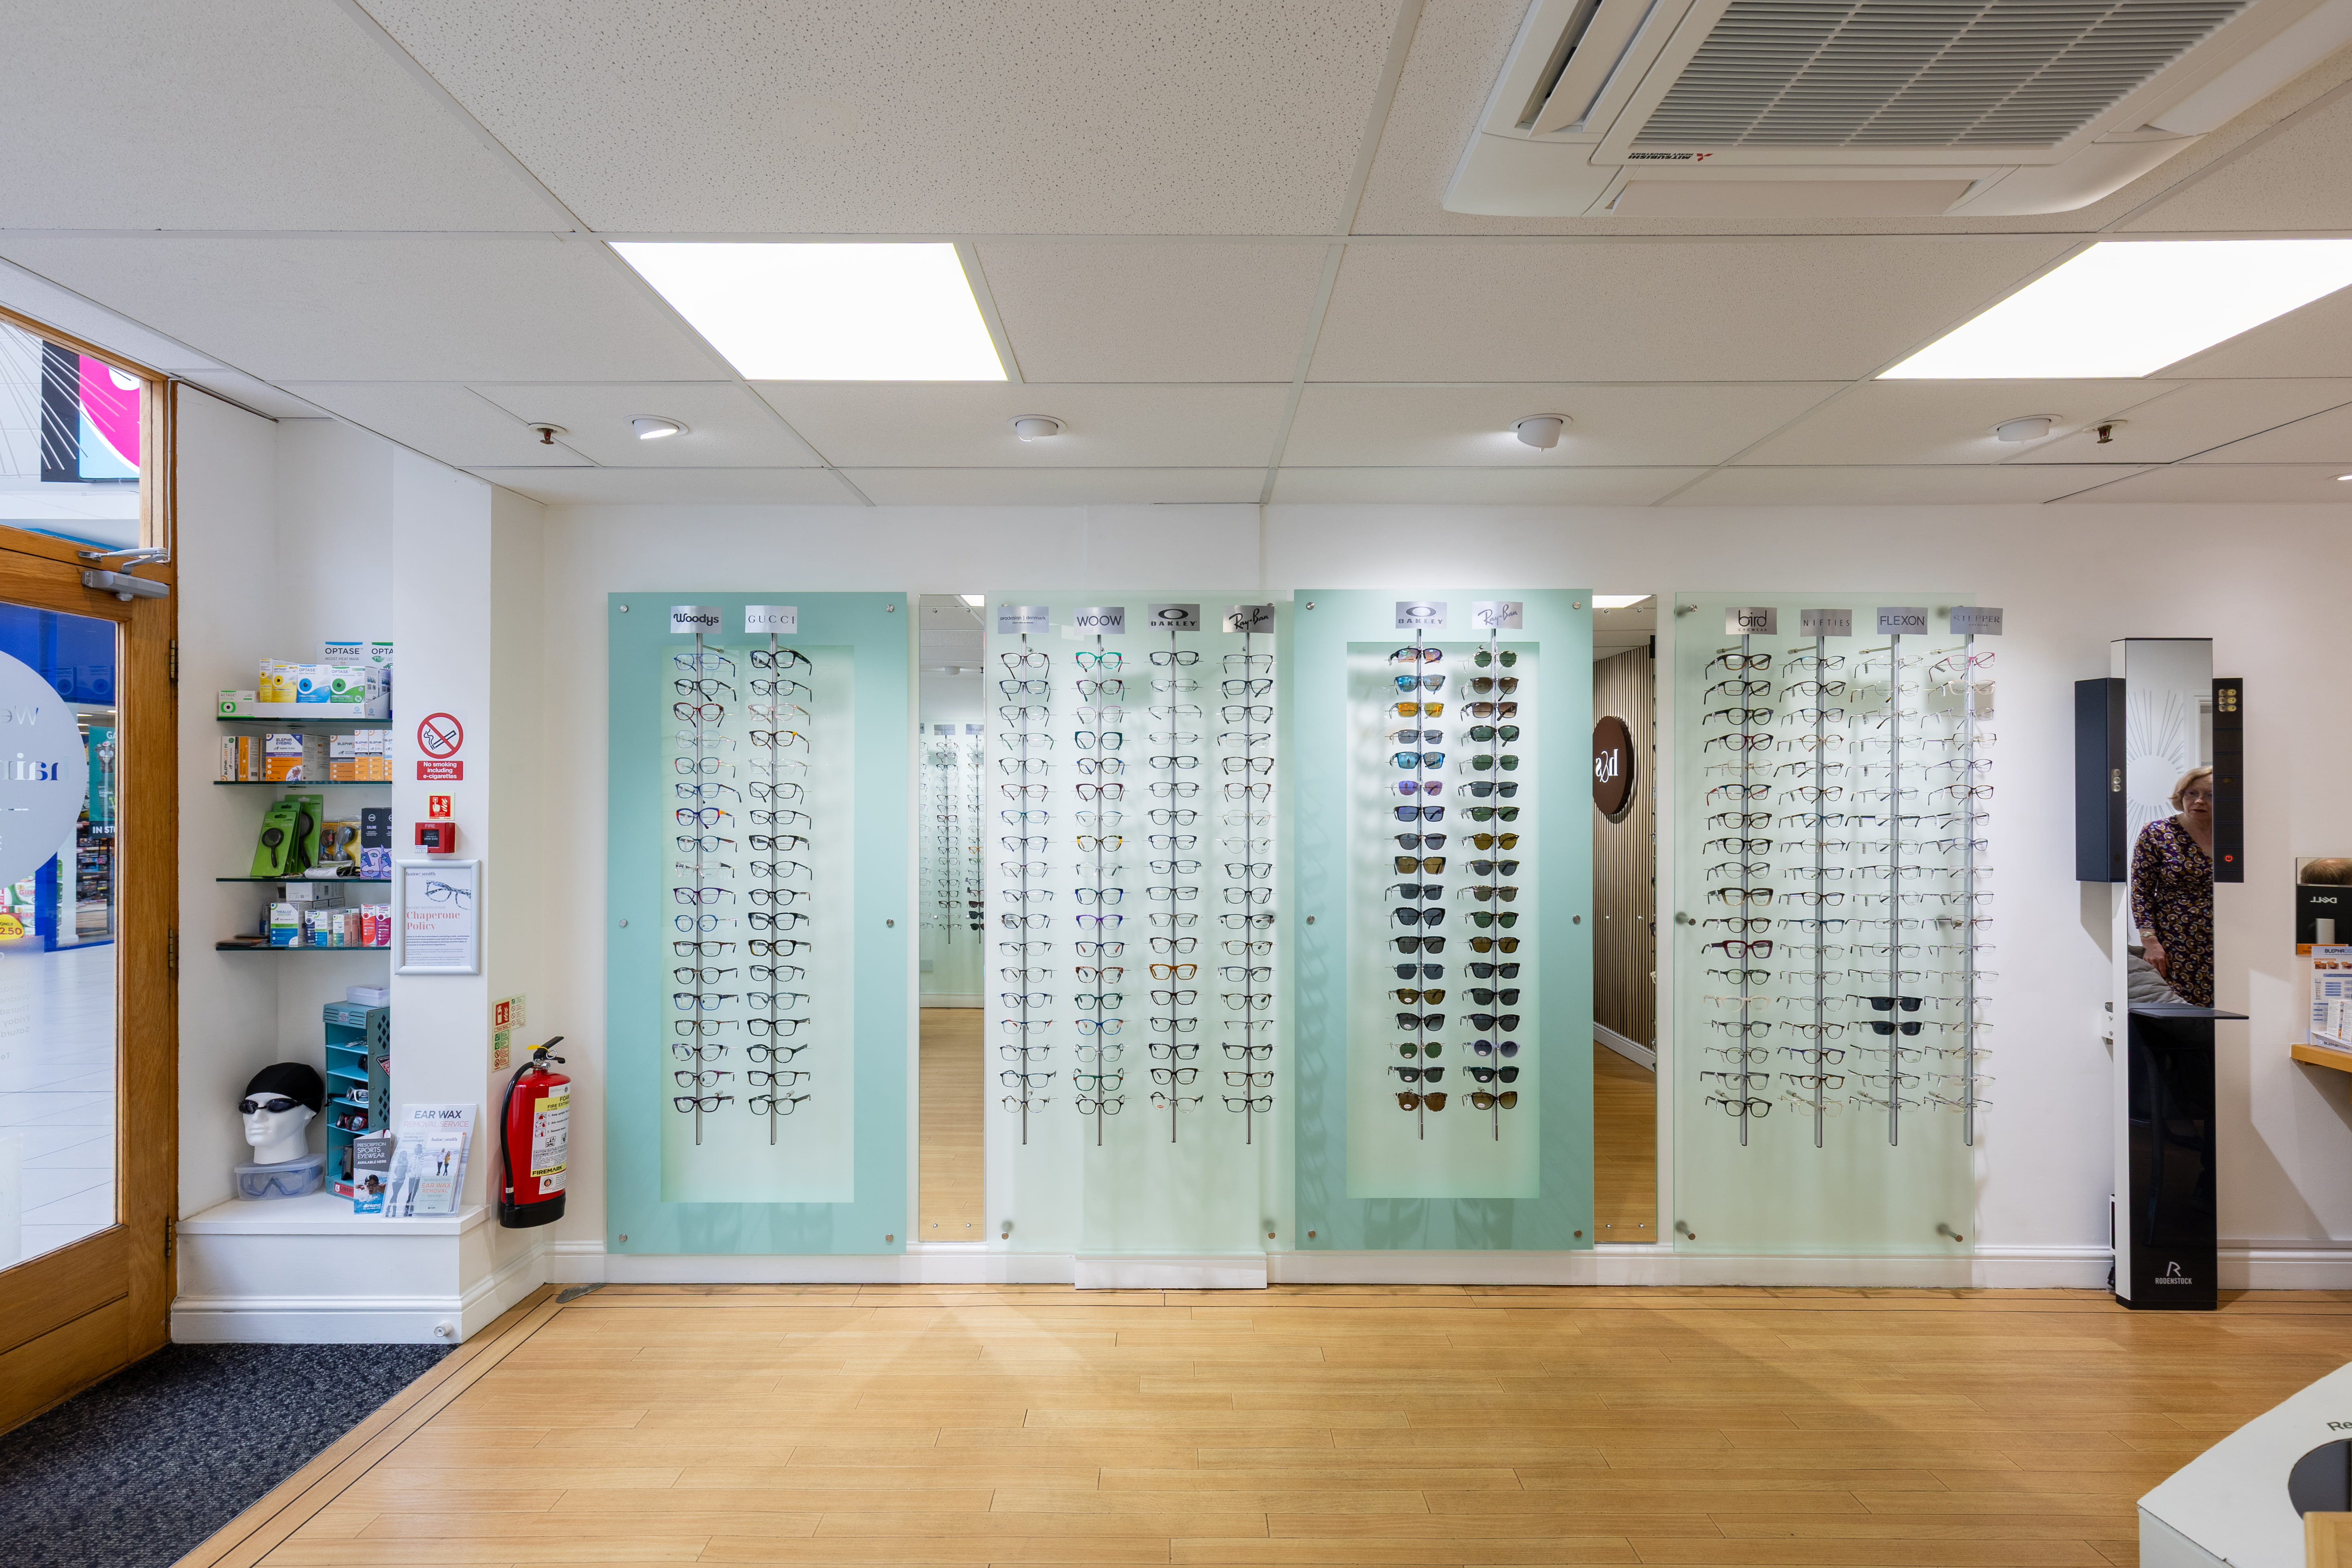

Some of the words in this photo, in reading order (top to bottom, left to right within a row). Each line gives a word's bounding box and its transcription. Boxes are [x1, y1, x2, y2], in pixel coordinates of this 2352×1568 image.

[673, 613, 719, 626] Woodys
[748, 615, 794, 624] GUCCI
[1229, 608, 1269, 630] Ray-Ban
[1477, 604, 1518, 625] Ray-Ban
[1738, 610, 1767, 627] bird
[1953, 615, 2000, 623] STEPPER
[1076, 615, 1122, 626] WOOW
[1880, 616, 1925, 626] FLEXON
[407, 911, 460, 921] Chaperone
[407, 921, 436, 931] Policy
[414, 1110, 436, 1119] EAR
[438, 1110, 462, 1119] WAX
[532, 1165, 562, 1175] FIREMARK
[2326, 1421, 2352, 1431] Re
